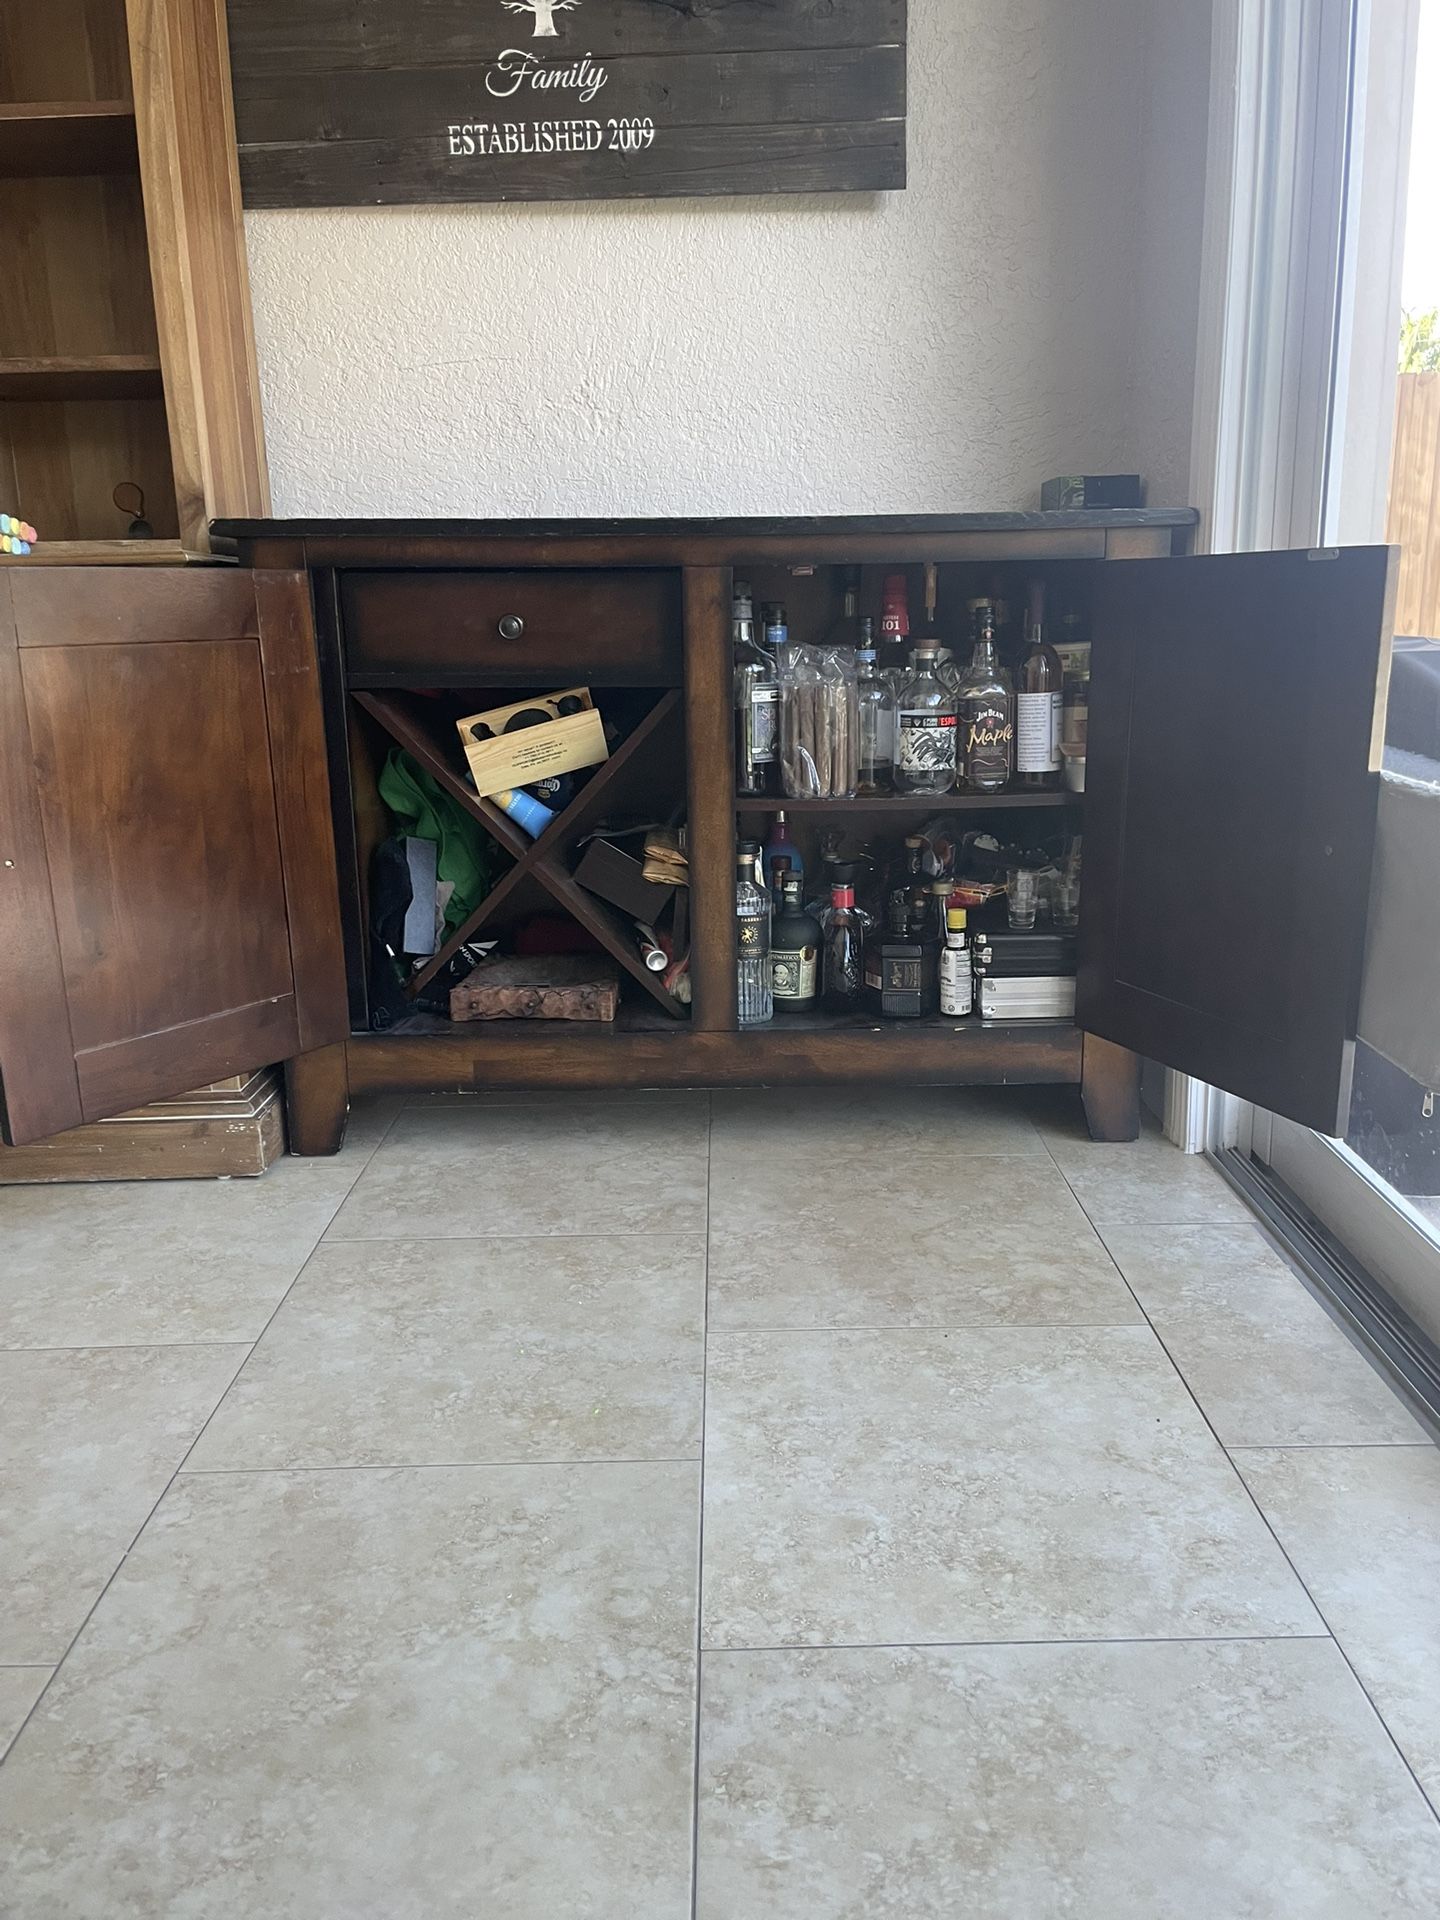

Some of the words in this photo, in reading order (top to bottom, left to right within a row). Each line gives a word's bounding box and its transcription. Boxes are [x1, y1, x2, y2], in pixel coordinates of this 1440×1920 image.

[485, 48, 608, 103] Family
[447, 119, 603, 155] ESTABLISHED
[606, 117, 655, 150] 2009
[882, 620, 900, 631] 101
[988, 708, 1004, 720] BEAM
[966, 723, 1013, 753] Maple
